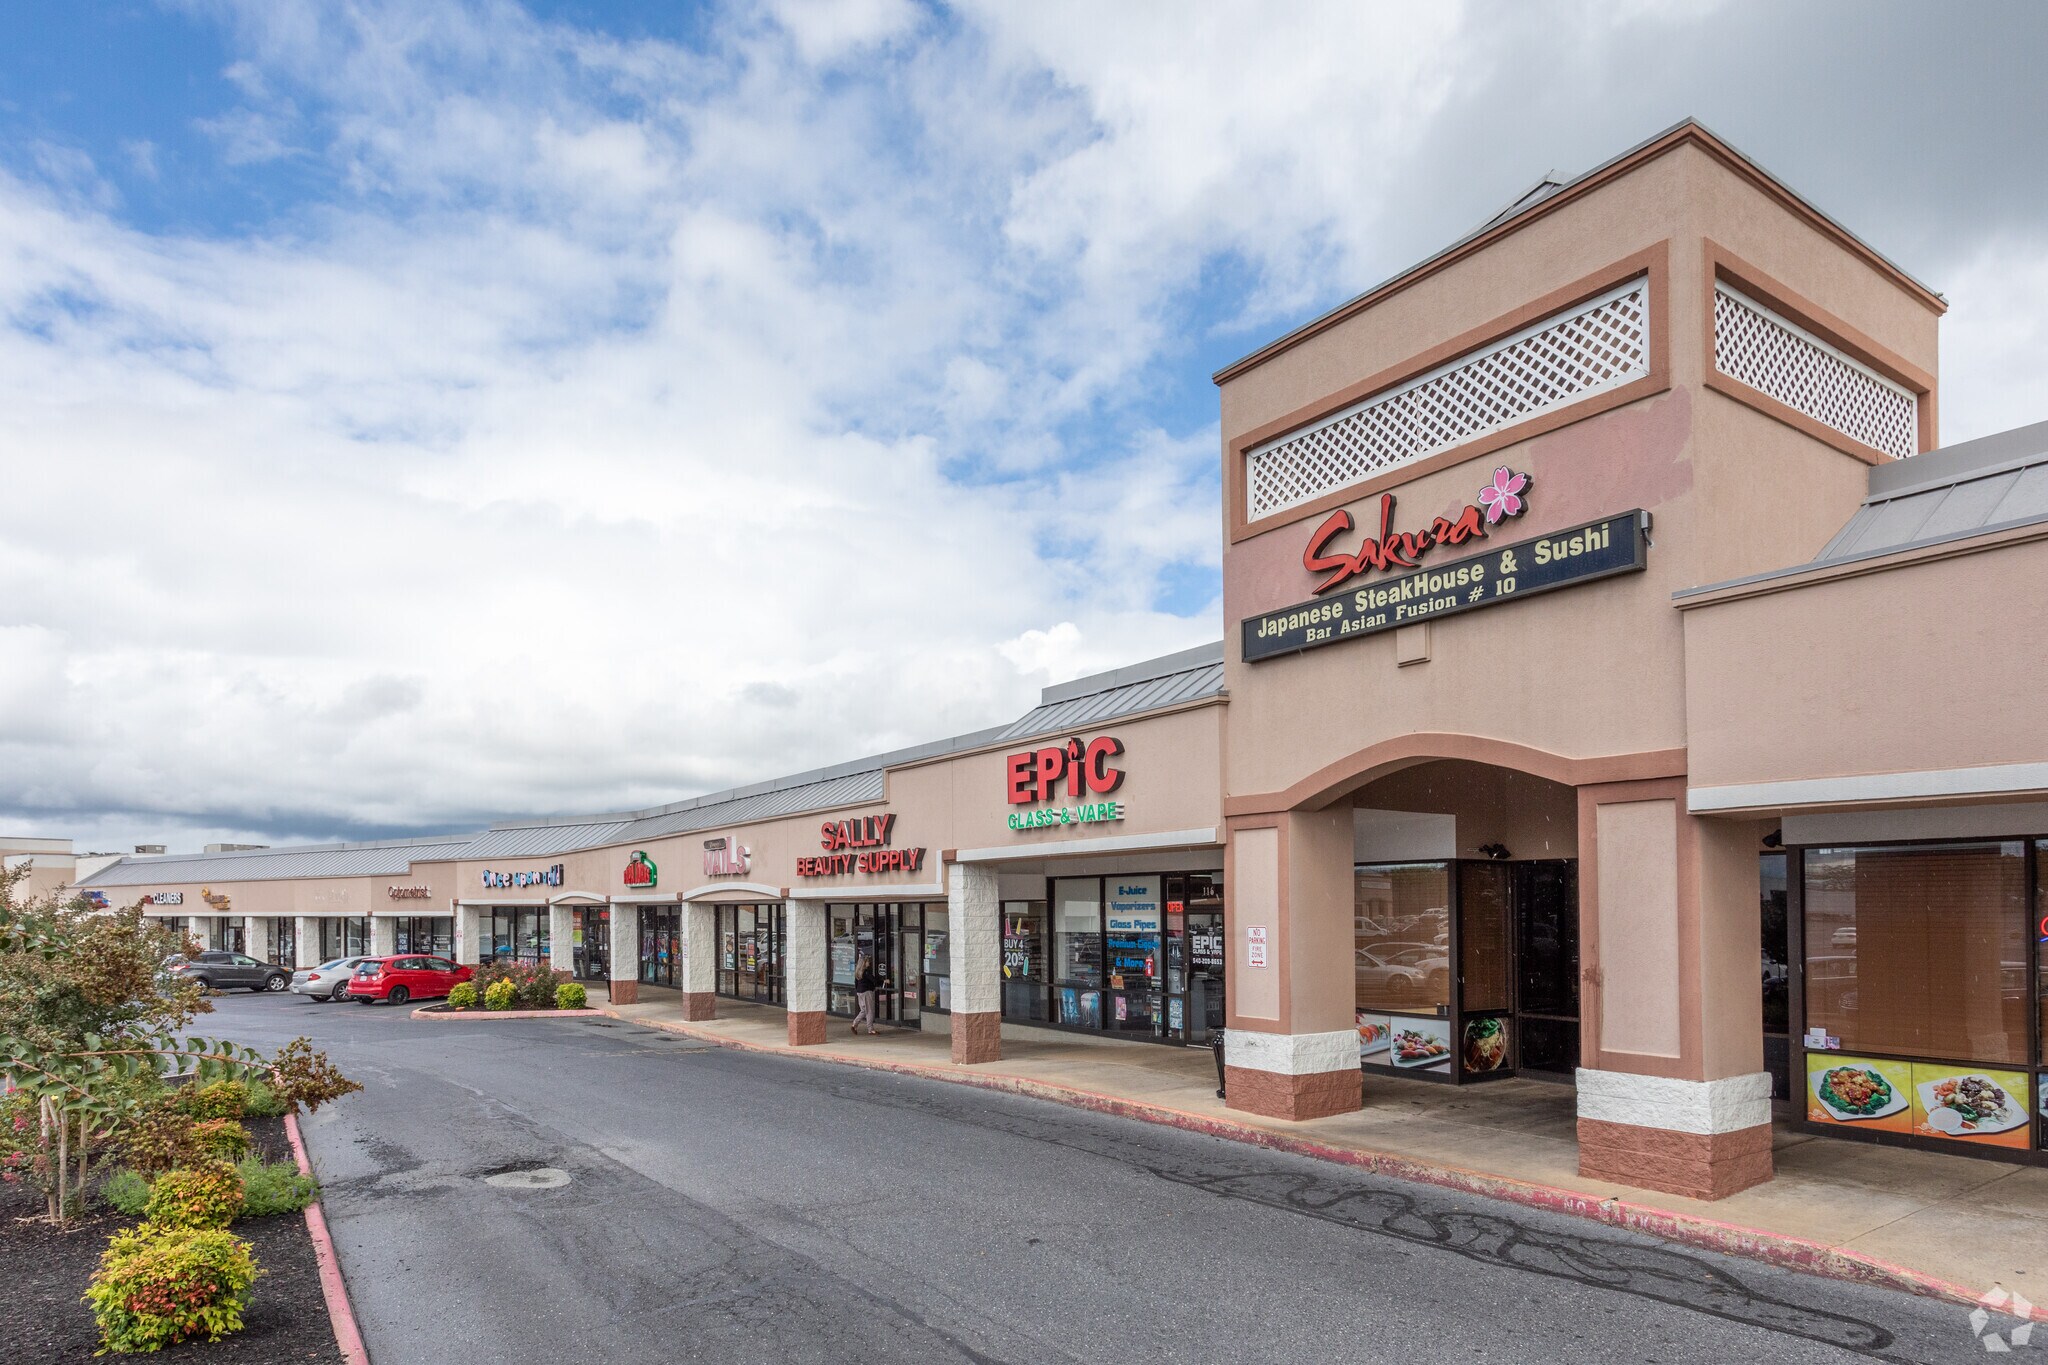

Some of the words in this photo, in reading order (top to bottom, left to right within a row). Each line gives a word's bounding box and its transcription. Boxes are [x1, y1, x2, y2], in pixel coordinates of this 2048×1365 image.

[1303, 493, 1488, 595] Sakura
[1258, 602, 1343, 638] Japanese
[1355, 564, 1484, 613] SteakHouse
[1500, 550, 1518, 574] &
[1534, 523, 1610, 565] Sushi
[1306, 627, 1332, 642] Bar
[1340, 613, 1386, 634] Asian
[1396, 595, 1456, 620] Fusion
[1468, 585, 1484, 603] #
[1496, 577, 1516, 596] 10
[1008, 808, 1055, 830] GLASS
[1061, 807, 1071, 824] &
[1077, 802, 1119, 822] VAPE
[821, 814, 892, 850] SALLY
[797, 854, 853, 876] BEAUTY
[858, 847, 922, 874] SUPPLY
[482, 870, 511, 888] Once
[514, 871, 541, 888] upon
[388, 886, 429, 901] Optometrist
[1118, 886, 1147, 895] E-Juice
[1203, 886, 1215, 896] 116
[153, 893, 183, 904] CLEANERS
[1111, 901, 1156, 912] Vaporizers
[1110, 920, 1132, 929] Glass
[1134, 919, 1156, 931] Pipes
[1004, 939, 1018, 949] BUY
[1018, 940, 1024, 949] 4
[1108, 939, 1136, 949] Premium
[1192, 935, 1223, 949] EPIC
[1115, 957, 1121, 967] &
[1124, 957, 1144, 967] More
